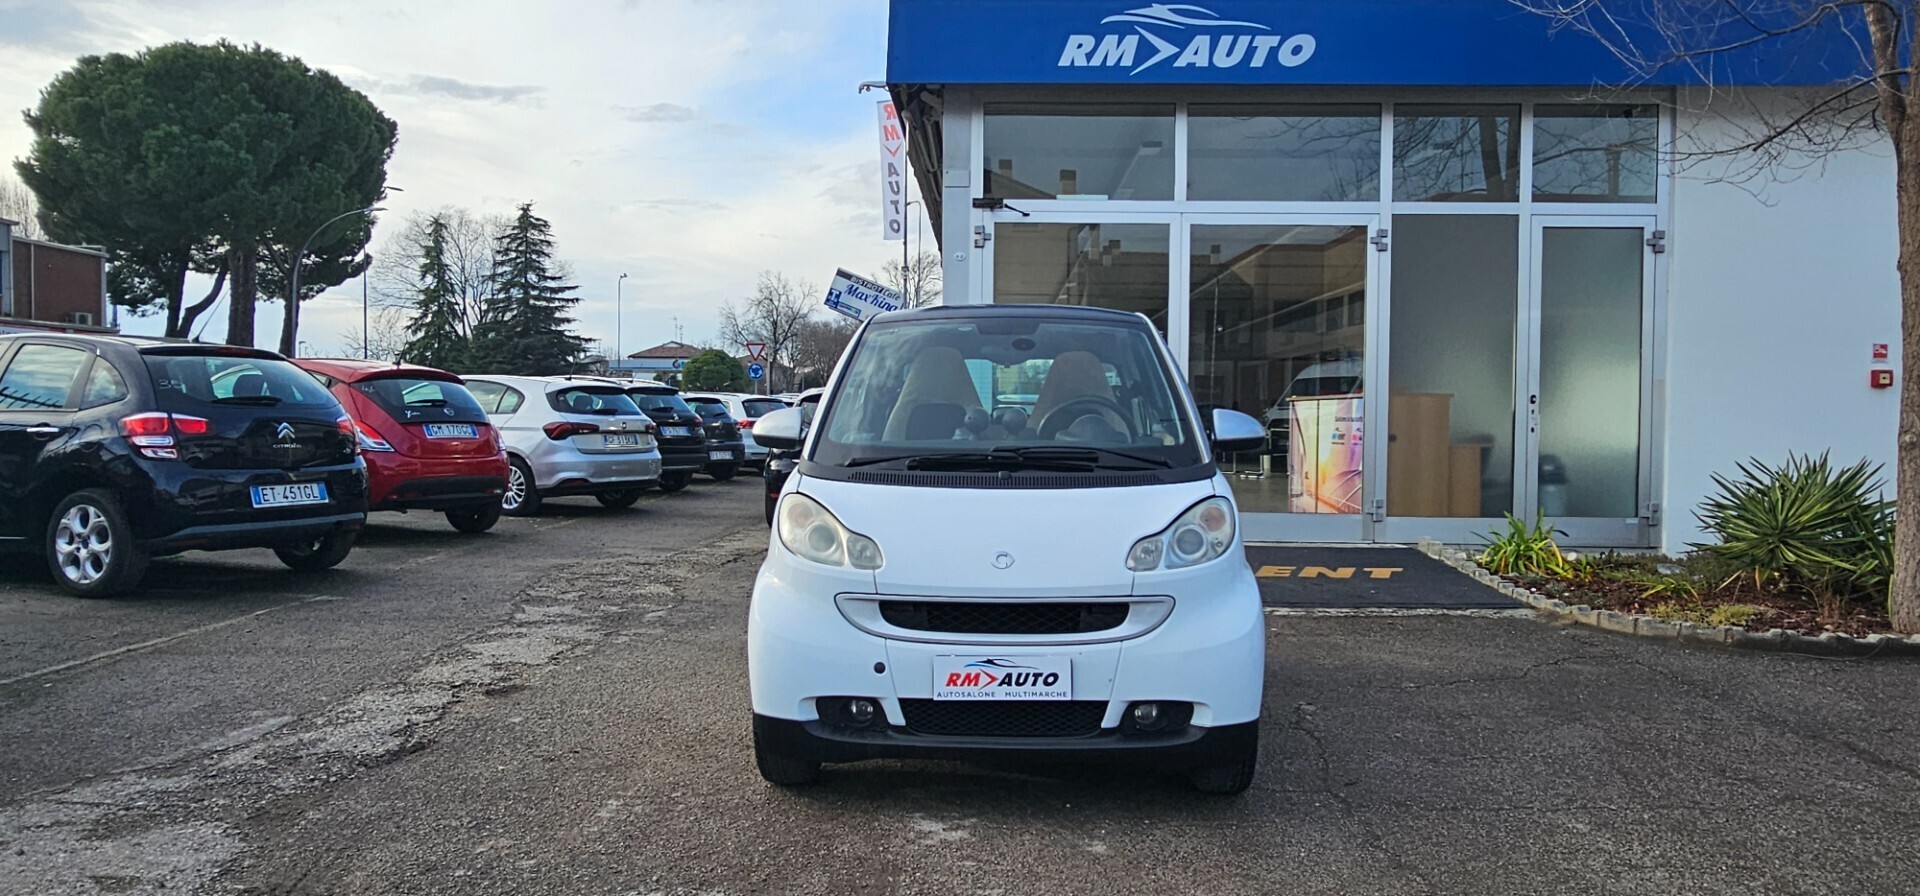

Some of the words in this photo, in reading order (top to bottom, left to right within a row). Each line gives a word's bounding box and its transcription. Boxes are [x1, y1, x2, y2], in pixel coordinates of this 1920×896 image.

[1058, 34, 1140, 67] RM
[1172, 34, 1317, 68] AUTO
[261, 487, 277, 502] ET
[282, 484, 319, 501] 451GL
[945, 672, 981, 687] RM
[997, 672, 1060, 687] AUTO
